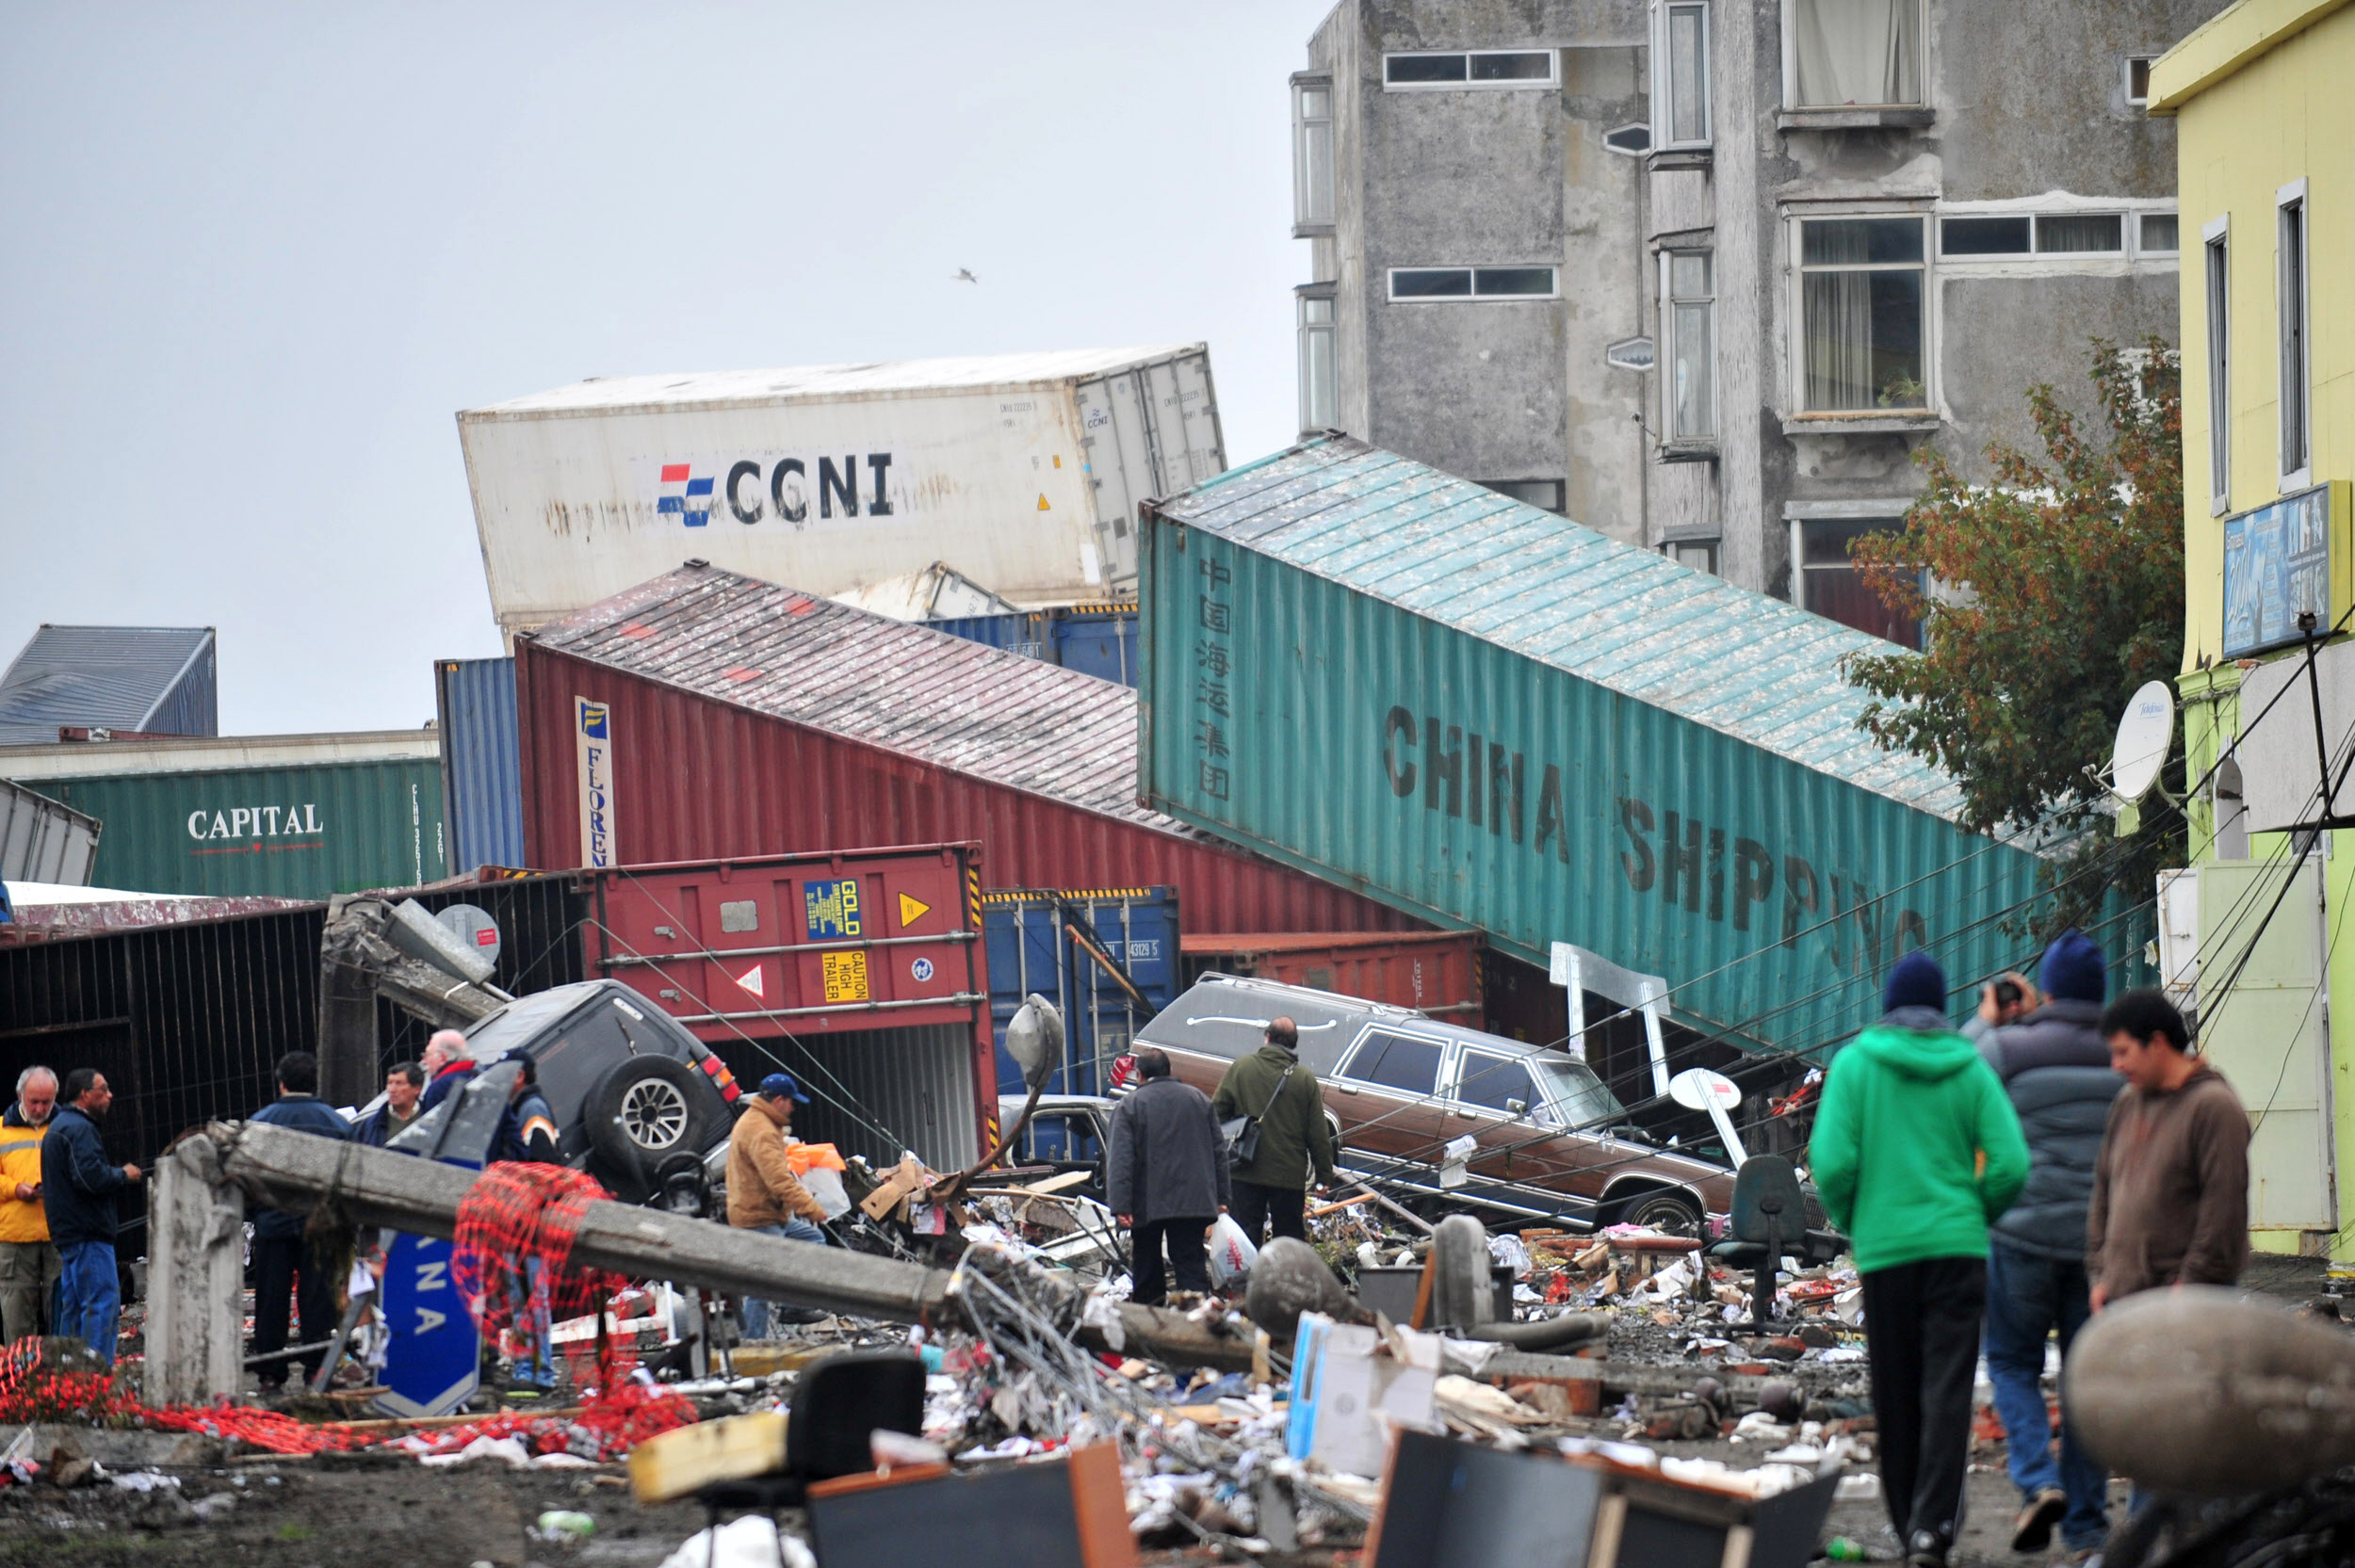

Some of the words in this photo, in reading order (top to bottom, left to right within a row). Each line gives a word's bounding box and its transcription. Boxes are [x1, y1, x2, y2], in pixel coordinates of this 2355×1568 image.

[1087, 415, 1109, 429] CCNI
[725, 452, 894, 525] CCNI
[1383, 704, 1570, 865] CHINA
[187, 803, 324, 840] CAPITAL
[841, 881, 860, 935] GOLD
[824, 955, 839, 999] TRAILER
[838, 963, 853, 989] HIGH
[851, 952, 867, 999] CAUTION
